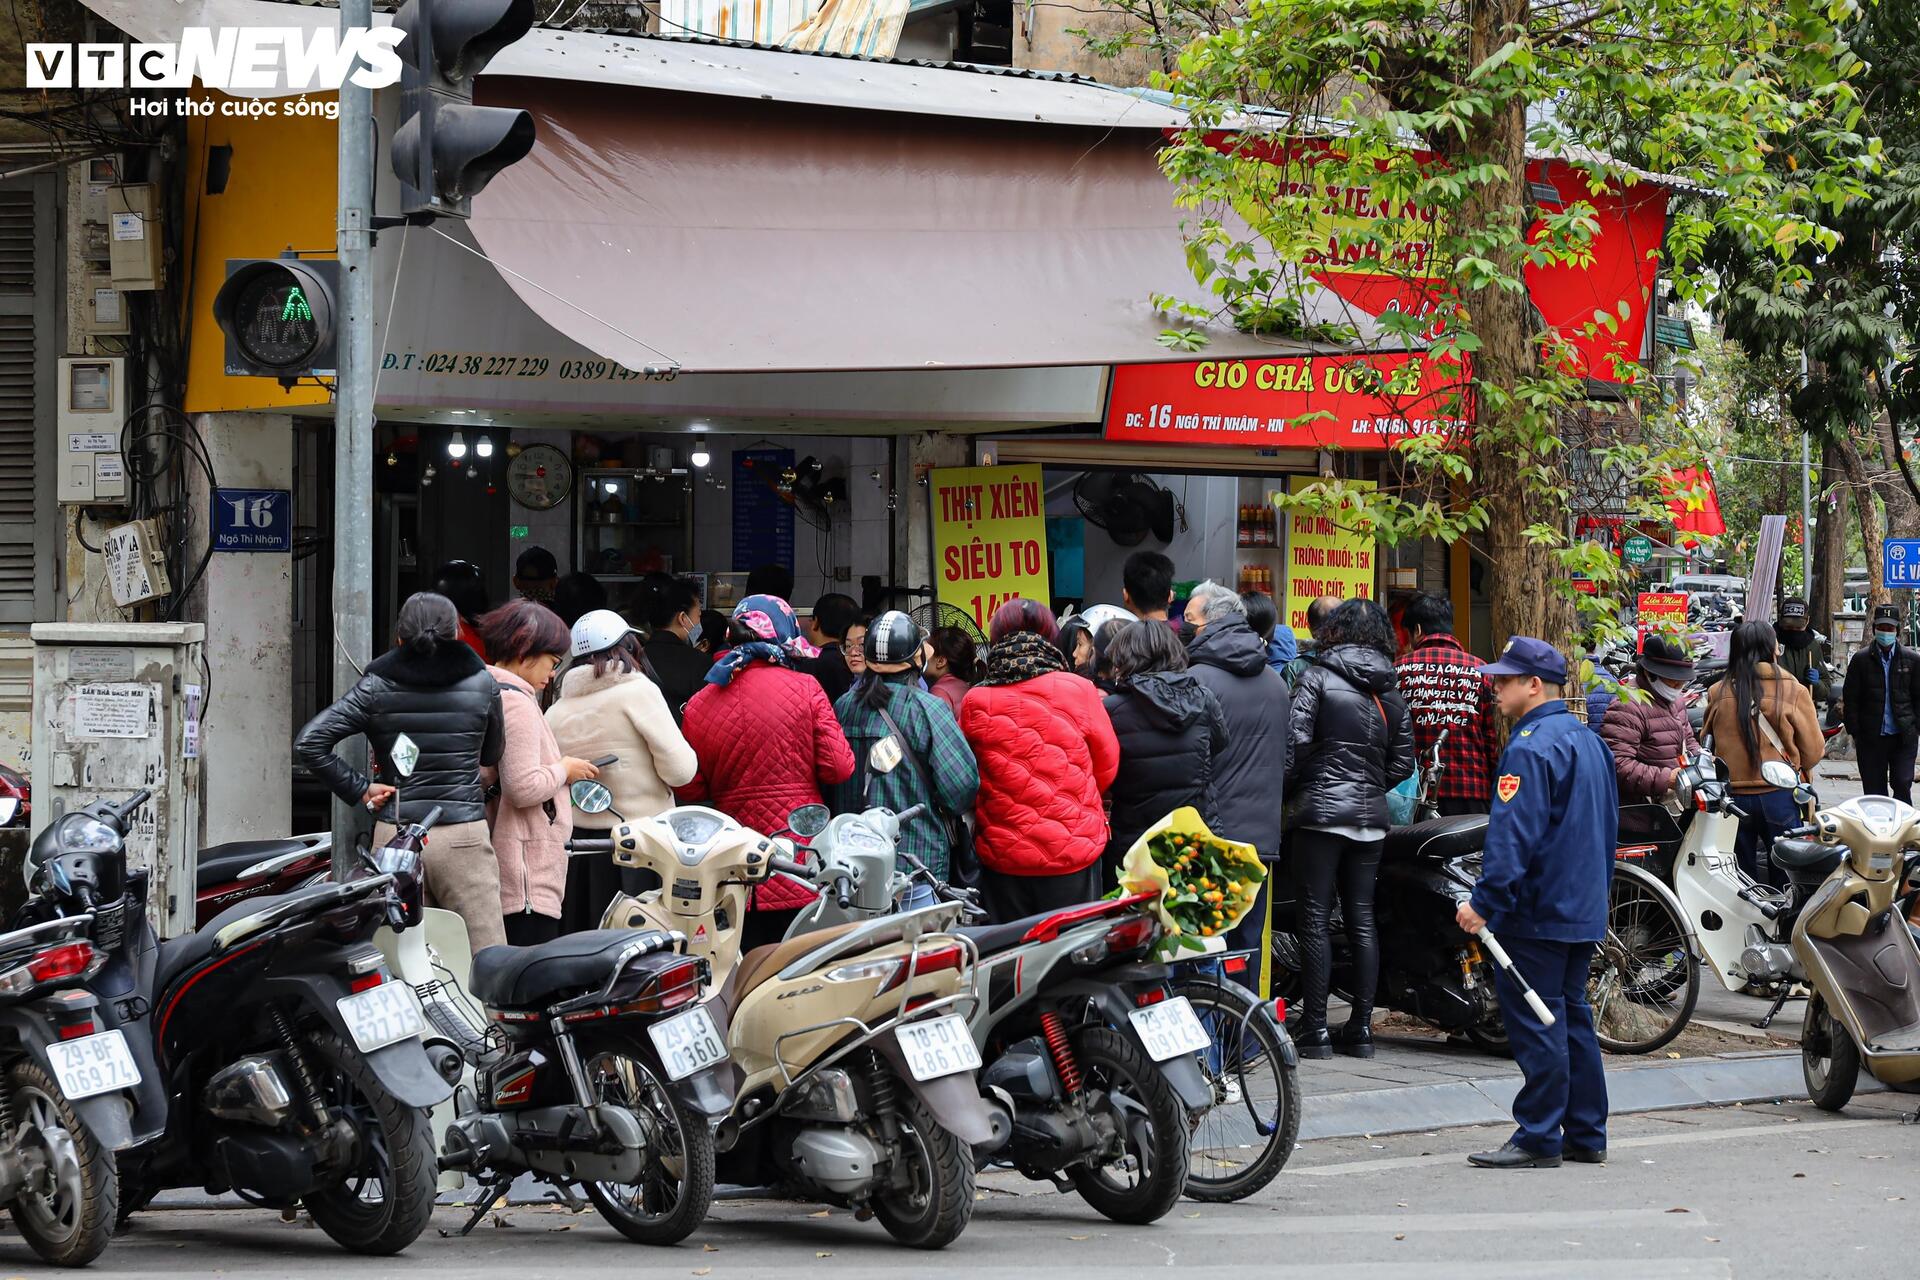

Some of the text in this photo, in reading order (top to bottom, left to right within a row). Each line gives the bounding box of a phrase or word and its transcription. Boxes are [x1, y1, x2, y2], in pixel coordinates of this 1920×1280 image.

[458, 355, 482, 376] 38
[483, 356, 516, 377] 227
[517, 357, 549, 377] 229
[559, 359, 604, 380] 0389
[1255, 356, 1315, 392] CHẢ
[1149, 404, 1172, 428] 16
[1174, 412, 1200, 429] NGÔ
[1223, 414, 1259, 434] NHẬM
[1267, 418, 1285, 433] HN
[229, 498, 273, 528] 16
[938, 474, 1040, 529] THỊT XIÊN
[219, 534, 239, 546] Ngô
[255, 534, 282, 547] Nhậm
[944, 536, 1041, 582] SIÊU TO
[1294, 544, 1370, 570] TRỨNG MUỐI: 15K
[1891, 560, 1906, 580] LÊ
[1293, 576, 1324, 598] TRỨNG
[1354, 582, 1369, 599] 13K
[350, 986, 404, 1022] 29-P1
[1140, 1003, 1183, 1033] 29-BF
[908, 1020, 958, 1050] 18-D1
[60, 1037, 113, 1069] 29-BF
[671, 1036, 719, 1073] 0360
[912, 1042, 976, 1075] 486.18
[64, 1060, 132, 1093] 069.74
